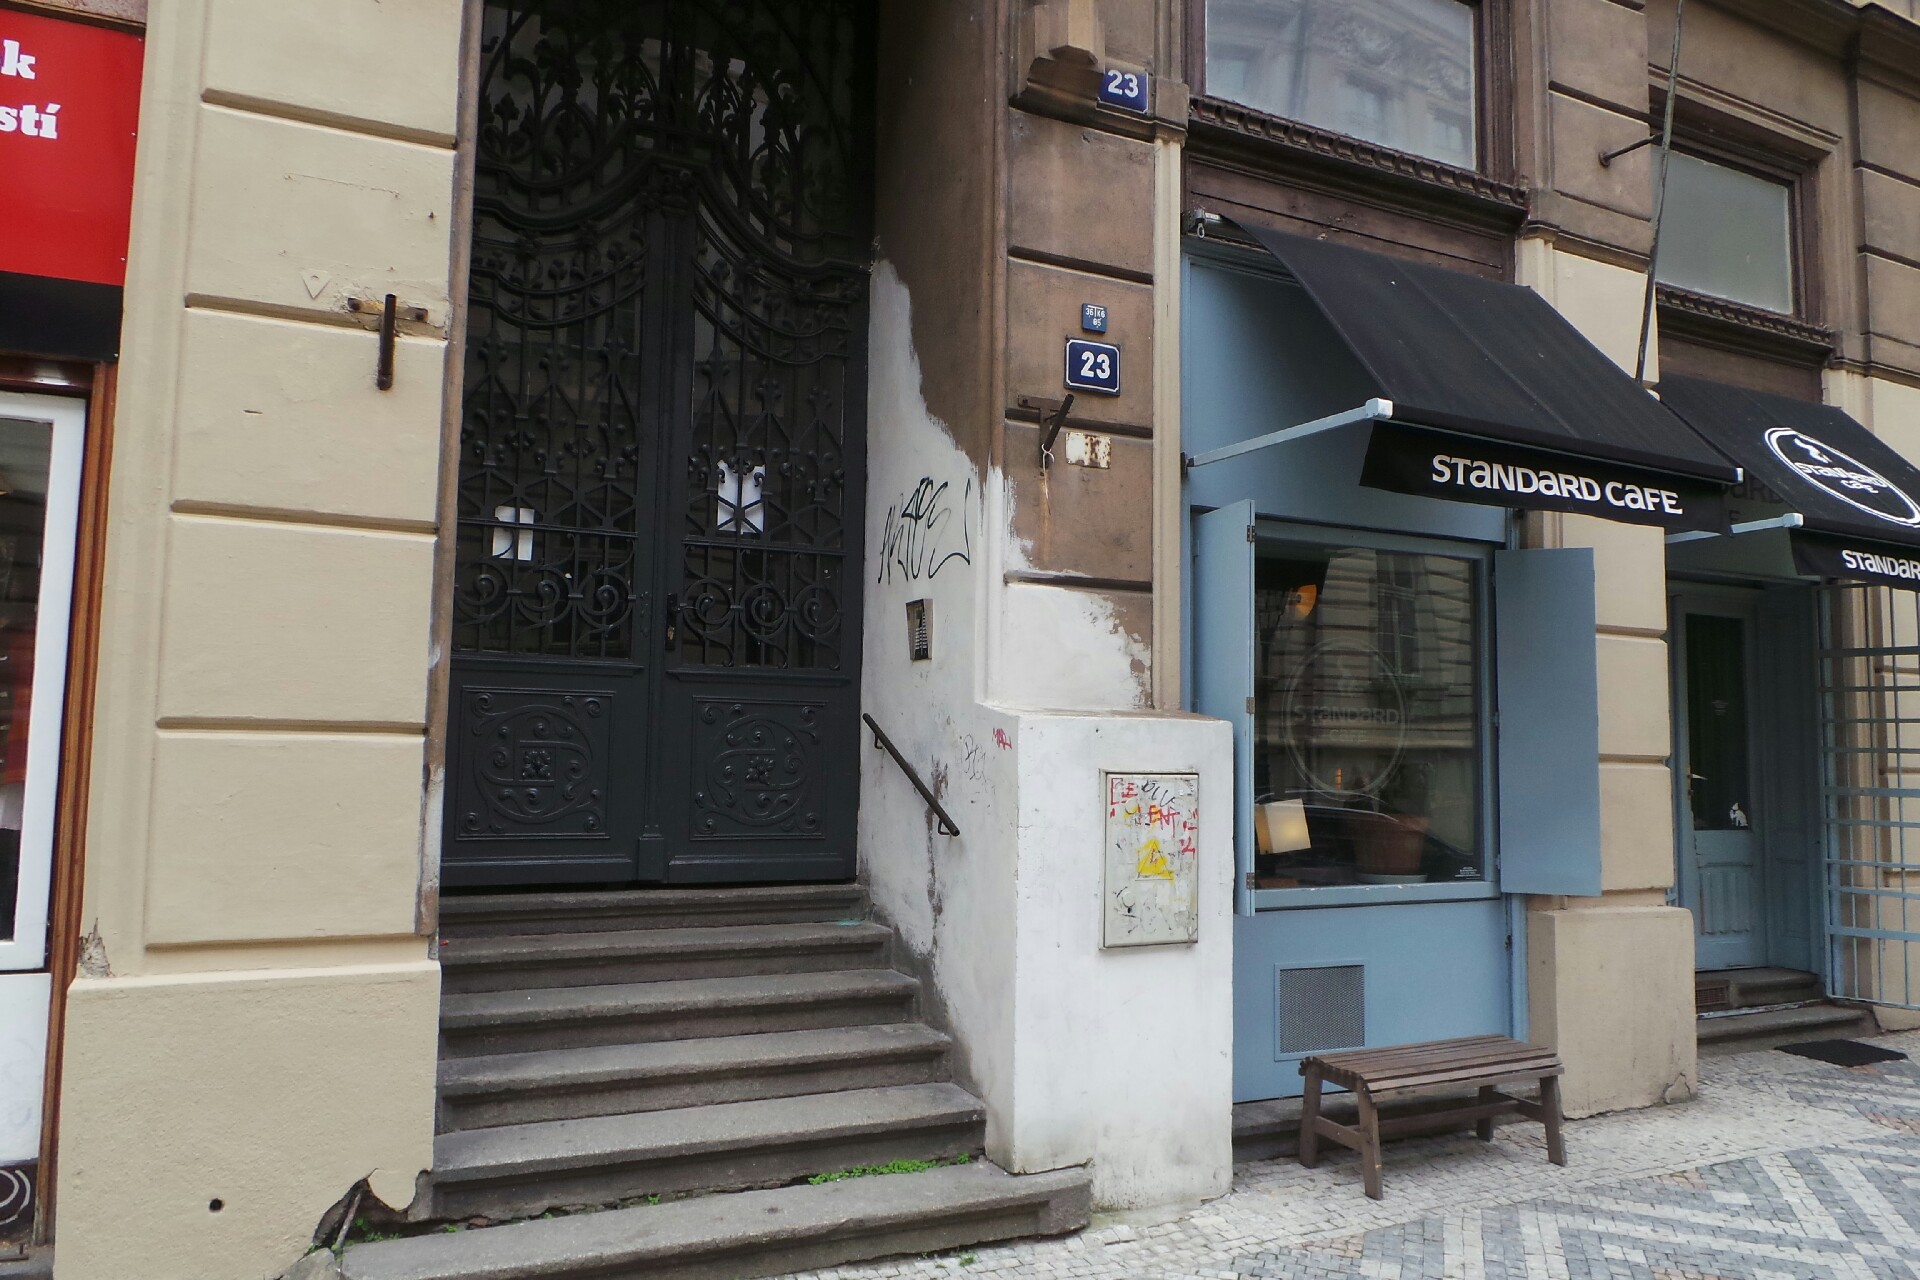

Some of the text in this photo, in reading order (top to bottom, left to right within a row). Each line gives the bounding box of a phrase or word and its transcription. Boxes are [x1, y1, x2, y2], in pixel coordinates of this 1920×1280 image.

[1, 39, 36, 80] k
[1107, 69, 1139, 98] 23
[0, 102, 62, 140] stí
[1080, 351, 1111, 379] 23
